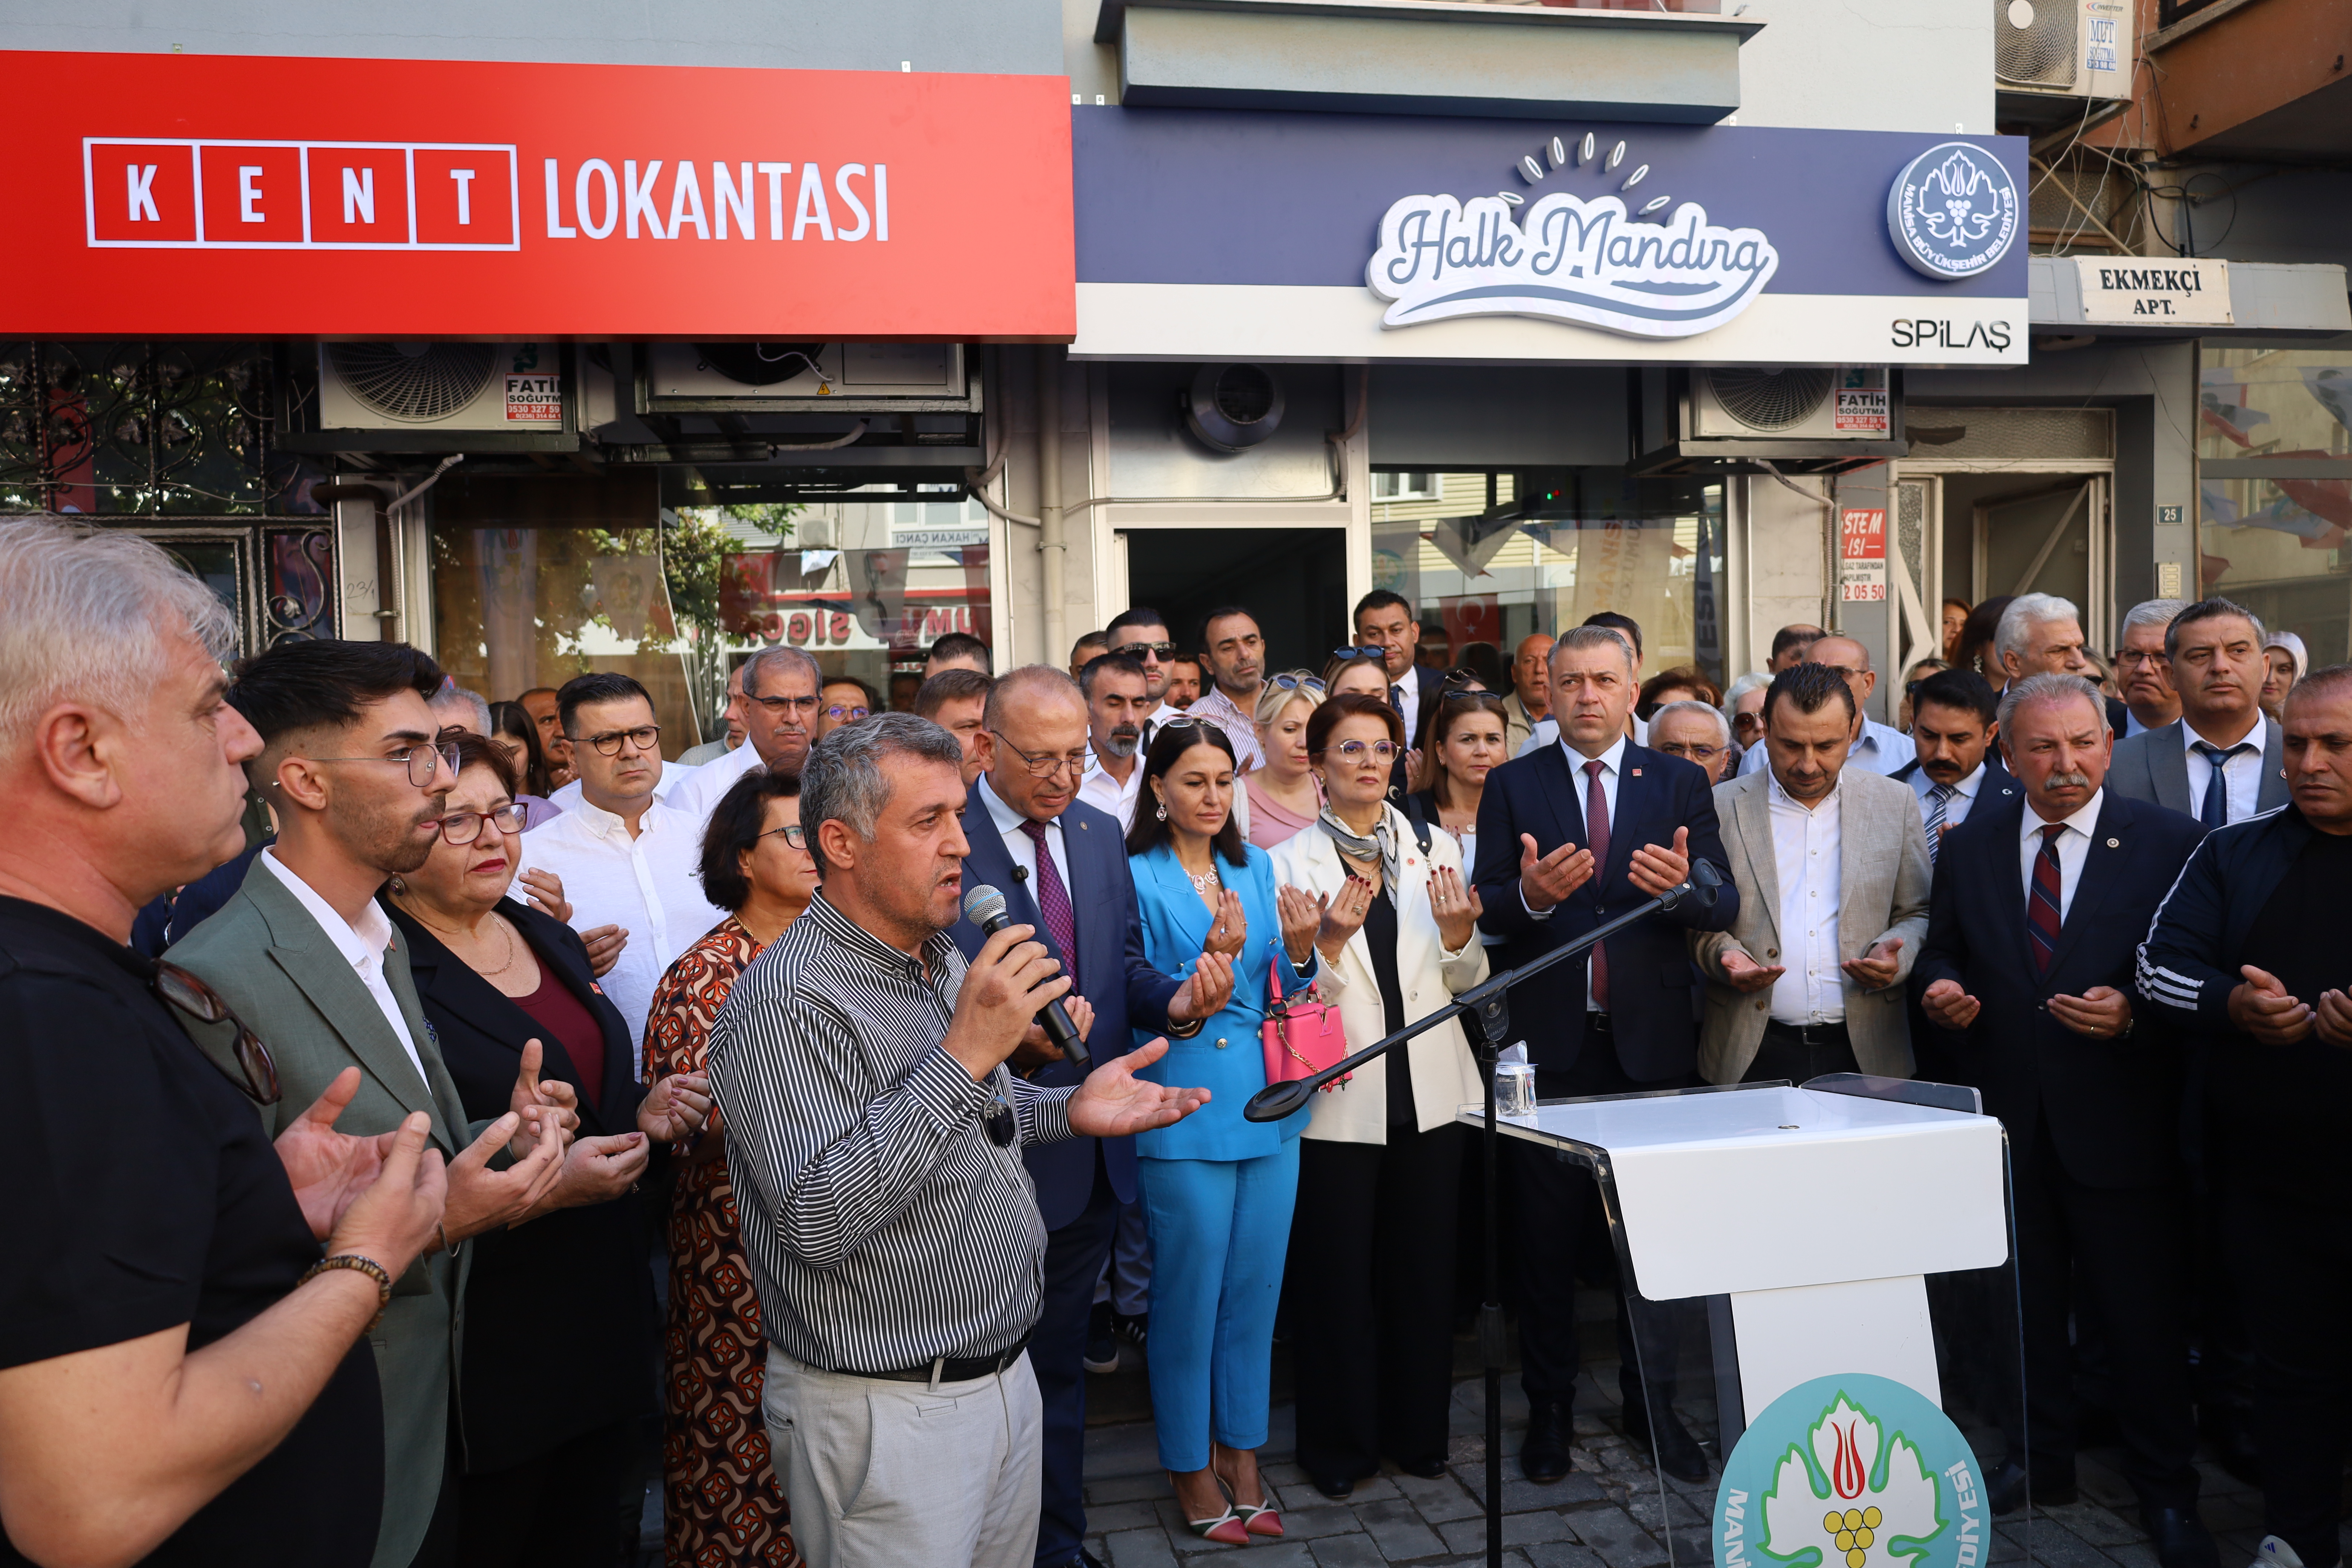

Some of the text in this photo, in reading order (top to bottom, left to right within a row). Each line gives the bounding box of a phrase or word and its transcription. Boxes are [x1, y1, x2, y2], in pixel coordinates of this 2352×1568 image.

[2090, 20, 2114, 43] MUT
[127, 157, 889, 242] KENT LOKANTASI
[1903, 183, 2013, 272] MANİSA BÜYÜKŞEHİR BELEDİYESİ
[1387, 207, 1769, 284] Halk Mandıra
[2099, 264, 2202, 297] EKMEKÇİ
[2133, 299, 2176, 315] APT.
[549, 405, 560, 413] 59
[1838, 392, 1886, 406] FATİH
[1842, 512, 1883, 534] STEM
[2164, 508, 2177, 521] 25
[1854, 584, 1868, 599] 05
[1871, 584, 1884, 599] 50
[1944, 1459, 1979, 1568] DİYESİ
